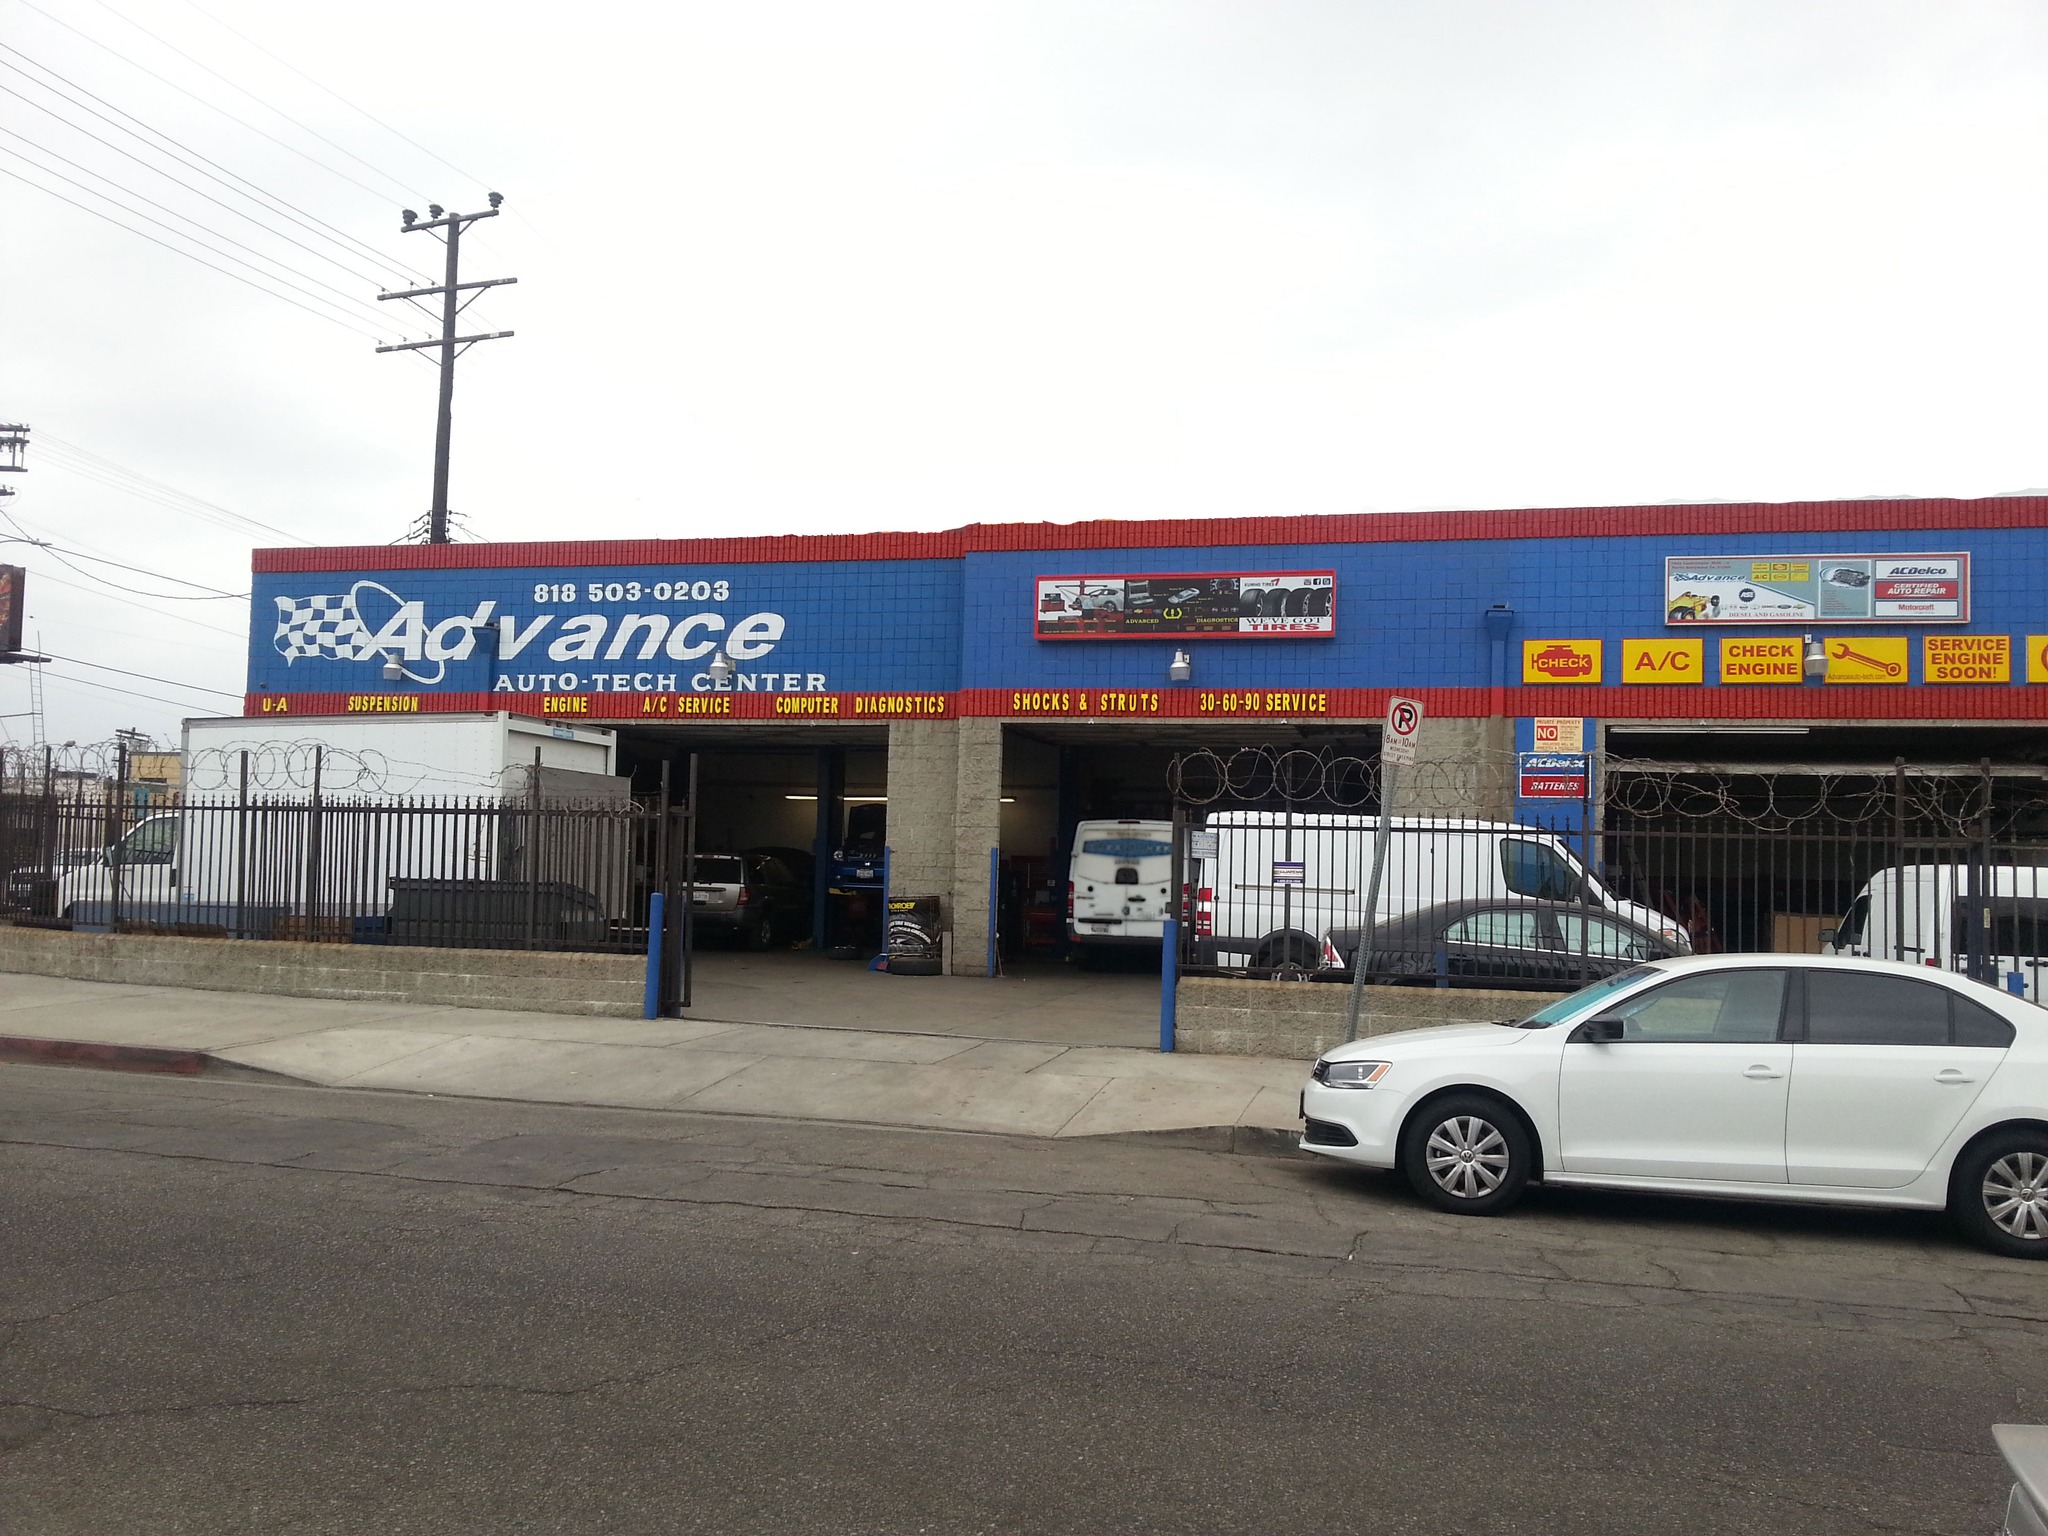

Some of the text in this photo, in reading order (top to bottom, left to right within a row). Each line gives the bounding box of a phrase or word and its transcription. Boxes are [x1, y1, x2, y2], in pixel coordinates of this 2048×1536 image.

[1889, 567, 1947, 575] ACDelco
[533, 580, 731, 602] 818 503-0203
[352, 600, 786, 661] Advance
[1249, 623, 1320, 631] TIRES
[1729, 645, 1794, 657] CHECK
[1928, 639, 2007, 651] SERVICE
[1538, 657, 1589, 668] CHECK
[1634, 651, 1690, 671] A/C
[1931, 653, 2004, 665] ENGINE
[1726, 663, 1798, 676] ENGINE
[1936, 667, 1997, 679] SOON!
[492, 672, 827, 693] AUTO-TECH CENTER
[347, 695, 419, 712] SUSPENSION
[543, 696, 588, 713] ENGINE
[643, 696, 730, 714] A/C SERVICE
[776, 695, 945, 714] COMPUTER DIAGNOSTICS
[1013, 692, 1159, 711] SHOCKS & STRUTS
[1200, 692, 1327, 712] 30-60-90 SERVICE
[1537, 727, 1557, 739] NO
[1531, 781, 1579, 791] BATTERIES
